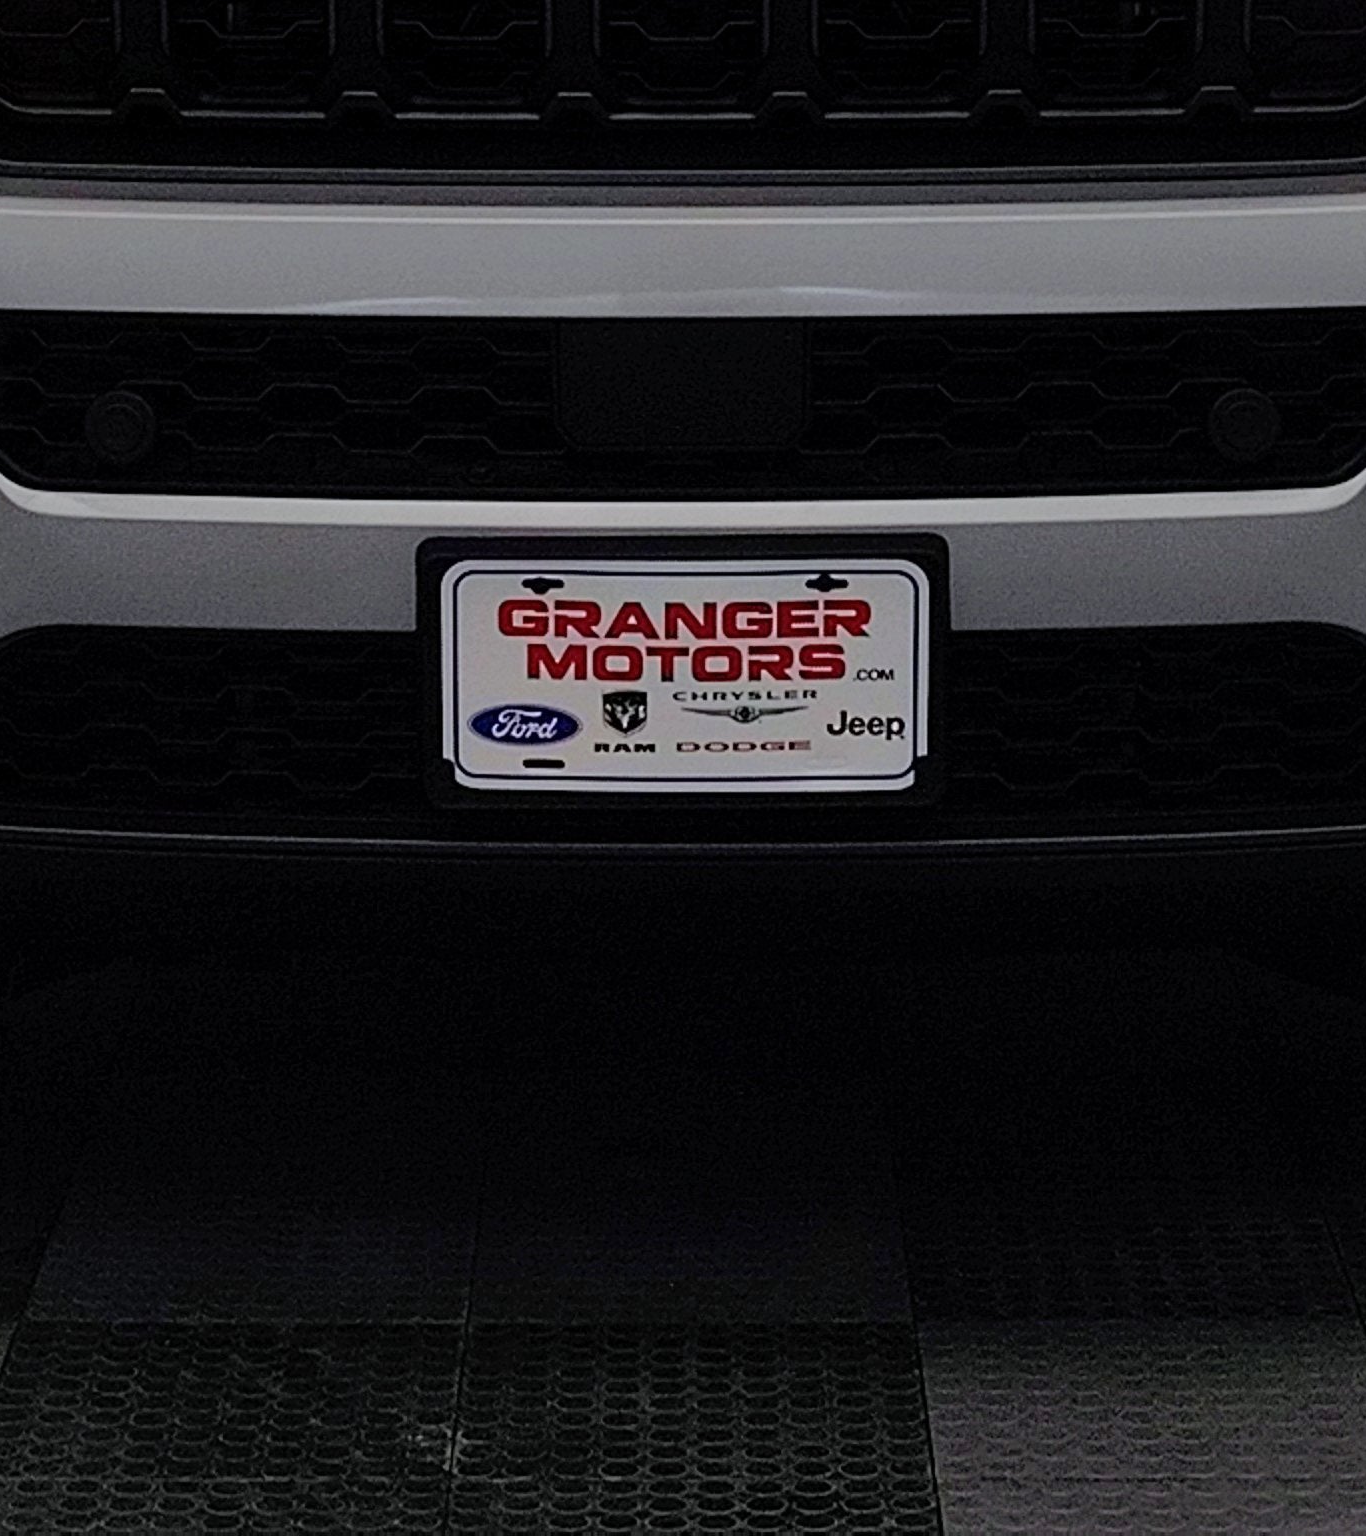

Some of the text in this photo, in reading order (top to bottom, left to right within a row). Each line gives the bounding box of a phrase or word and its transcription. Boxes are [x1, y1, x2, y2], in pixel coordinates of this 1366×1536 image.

[497, 599, 871, 639] GRANGER
[526, 643, 895, 683] MOTORS .COM
[672, 689, 818, 701] CHRYSLER
[491, 710, 558, 740] Ford
[827, 710, 906, 740] Jeep
[593, 742, 656, 753] RAM
[676, 740, 812, 753] DODGE
